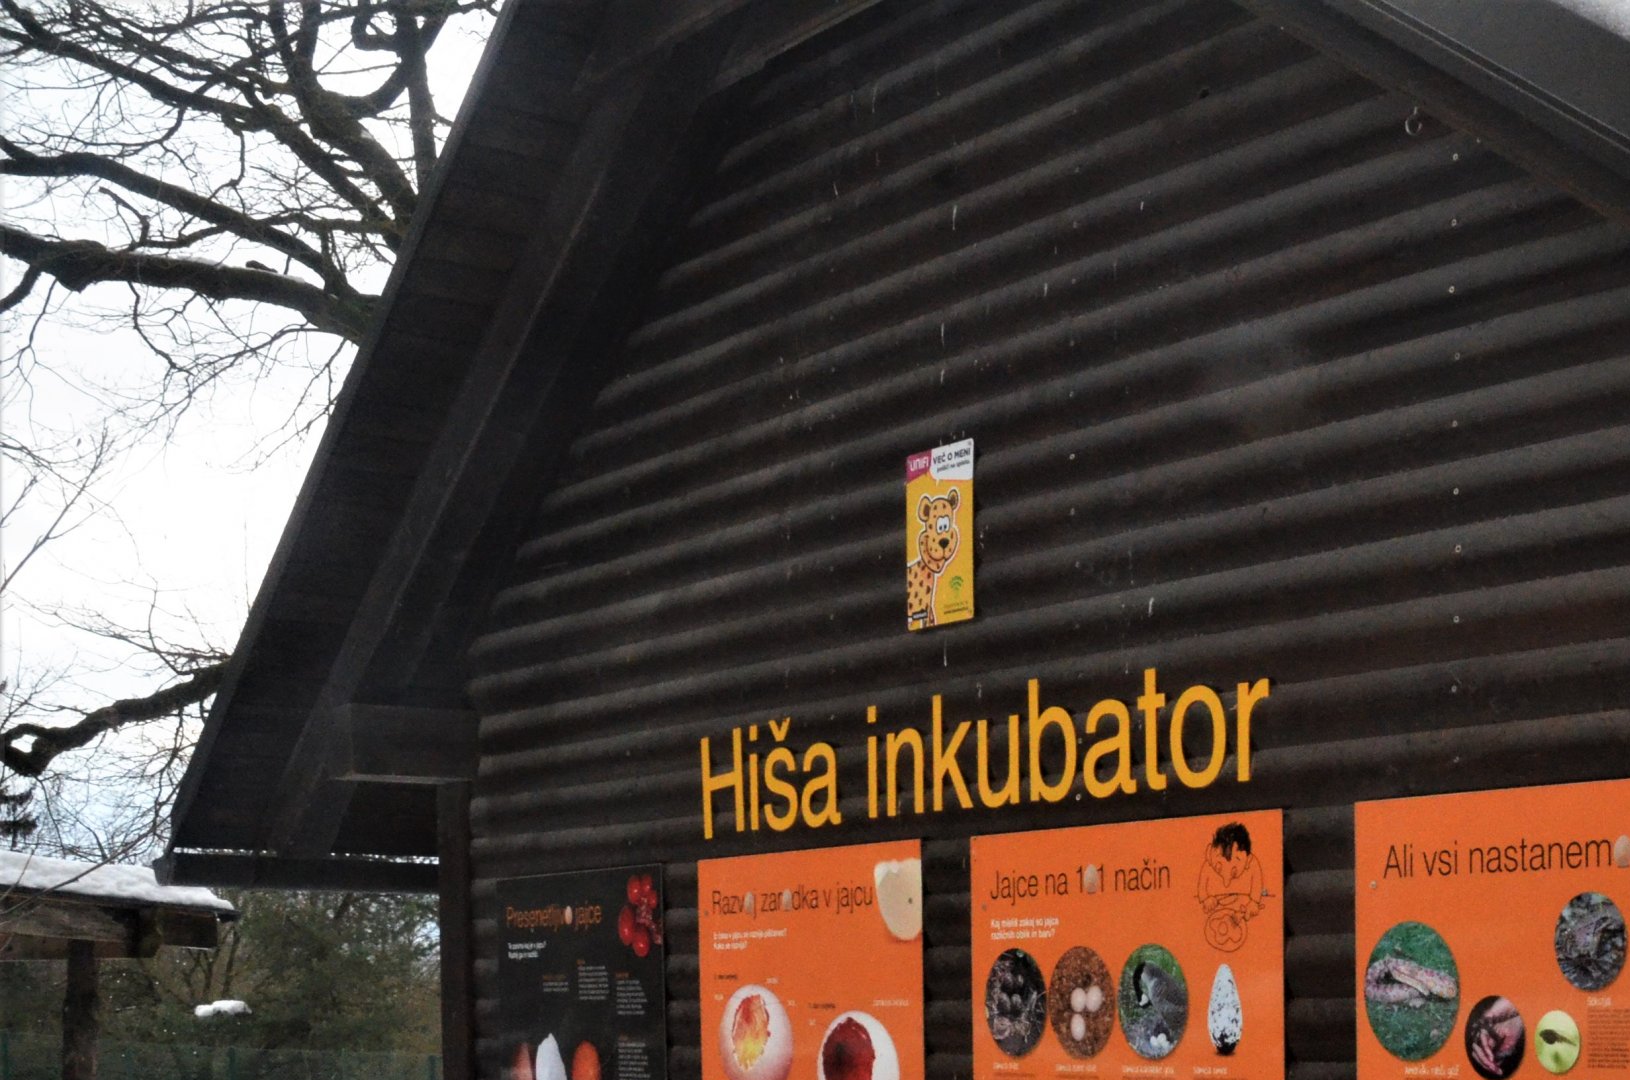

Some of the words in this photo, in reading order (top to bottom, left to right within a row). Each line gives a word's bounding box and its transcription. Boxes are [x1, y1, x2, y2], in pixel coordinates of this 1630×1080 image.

[947, 452, 953, 461] O
[954, 447, 971, 459] MENI
[700, 717, 842, 840] Hiša
[866, 667, 1270, 819] inkubator
[1383, 843, 1413, 880] Ali
[1423, 840, 1458, 876] vsi
[823, 888, 832, 908] v
[836, 881, 874, 914] jajcu
[990, 869, 1038, 906] Jajce
[1045, 872, 1068, 896] na
[1114, 858, 1171, 891] način
